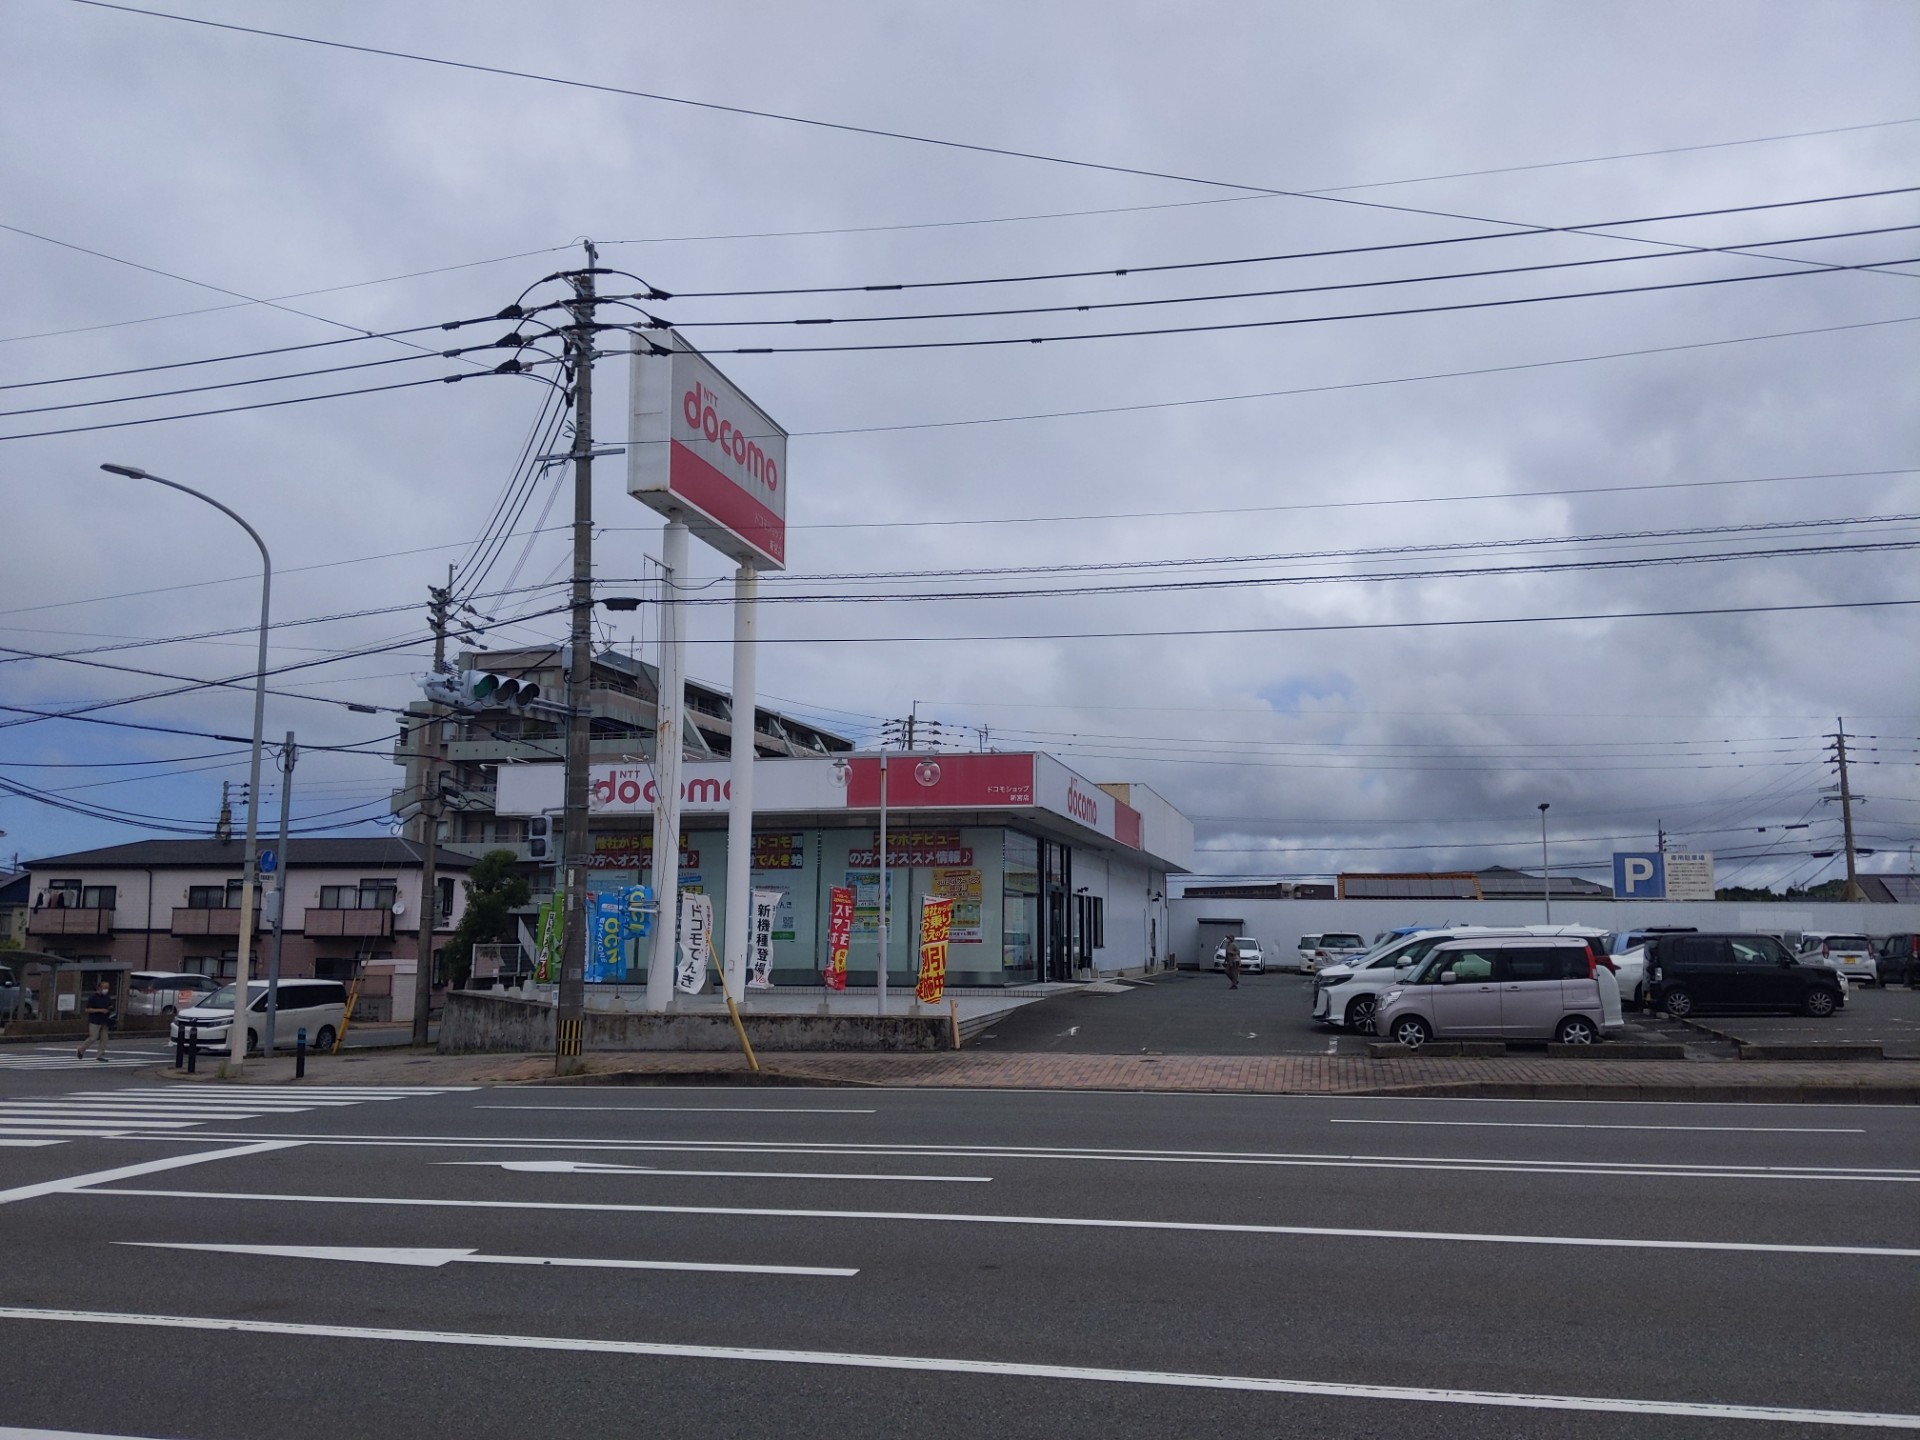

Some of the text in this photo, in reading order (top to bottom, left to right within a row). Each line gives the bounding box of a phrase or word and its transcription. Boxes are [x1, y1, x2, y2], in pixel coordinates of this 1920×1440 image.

[703, 386, 718, 408] NTT
[684, 381, 777, 492] docomo
[595, 770, 731, 804] docm
[619, 770, 640, 779] NTT
[987, 785, 1030, 793] ドコモショップ
[1067, 776, 1097, 826] docomo
[874, 831, 960, 846] スマホデビュー
[1624, 857, 1654, 893] P
[603, 917, 619, 964] OCN
[754, 904, 771, 975] 新機種登場
[831, 904, 844, 943] スマホ
[840, 905, 852, 946] ドコモ
[681, 904, 703, 989] ドコモでんき
